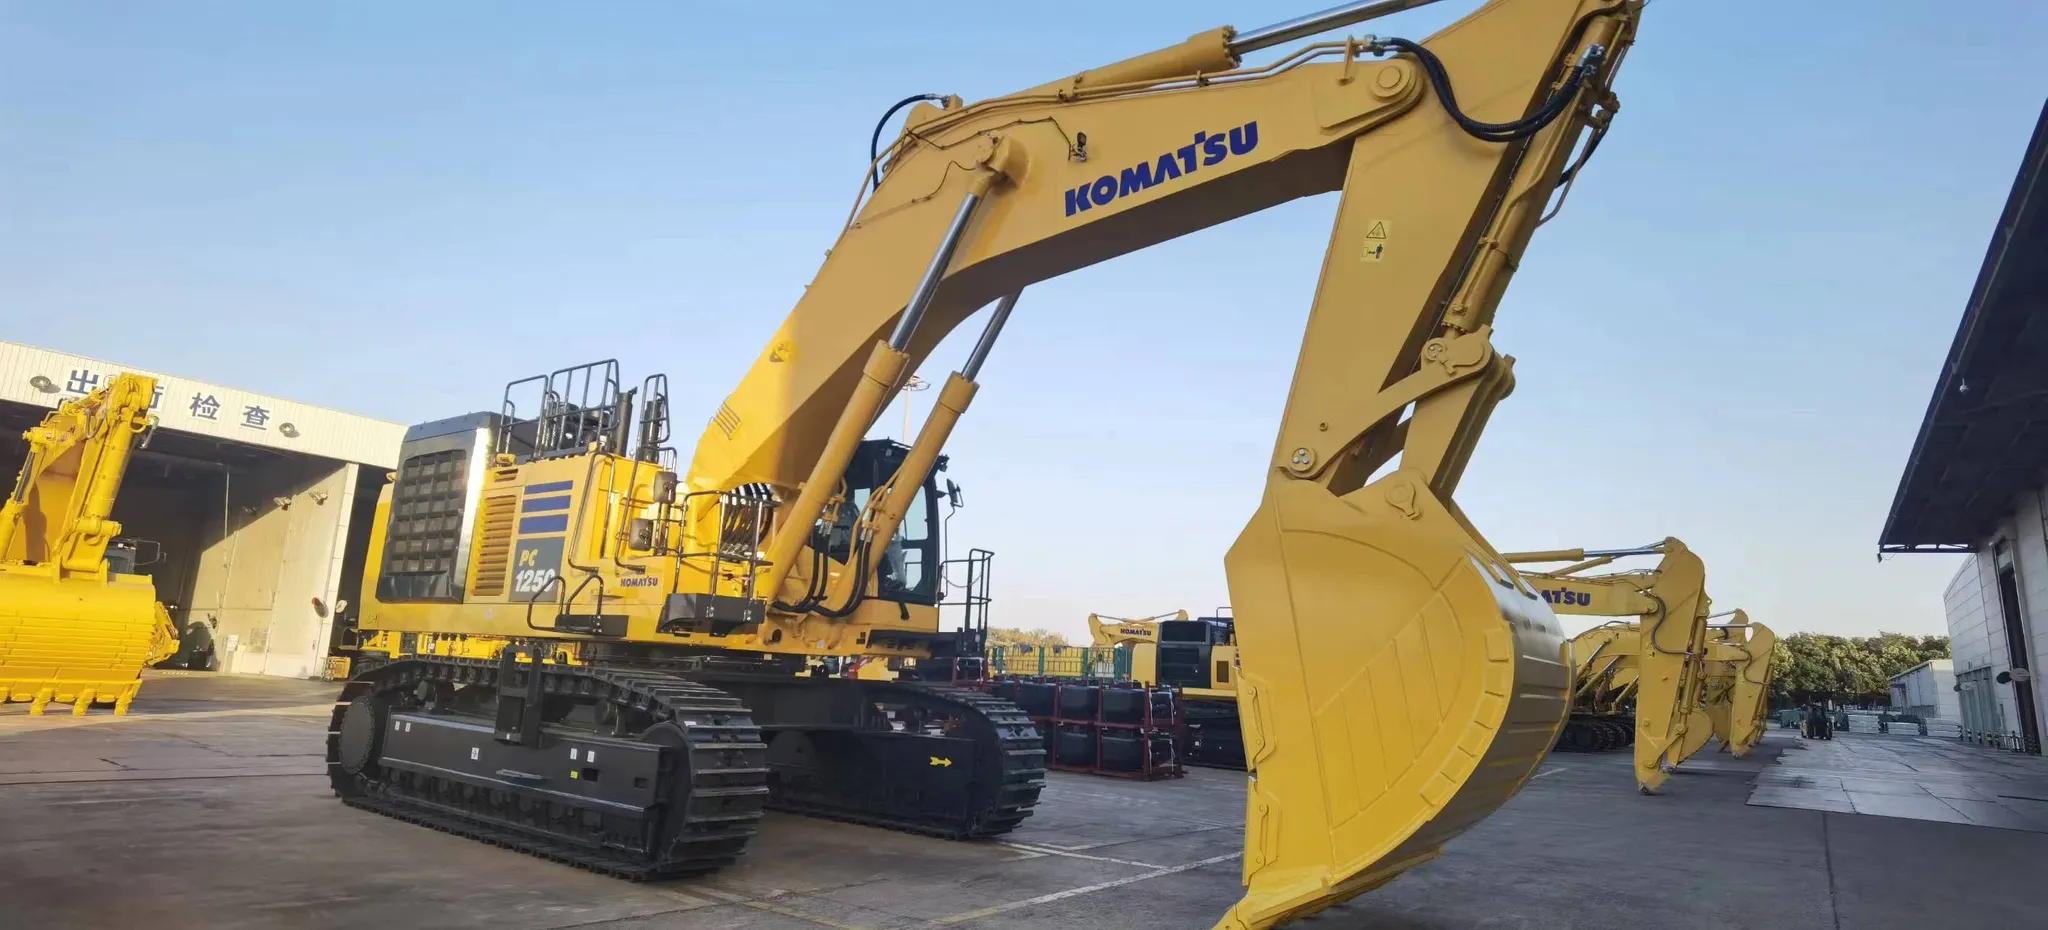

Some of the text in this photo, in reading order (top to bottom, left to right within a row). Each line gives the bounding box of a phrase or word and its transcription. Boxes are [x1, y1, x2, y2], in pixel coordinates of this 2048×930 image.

[1065, 121, 1258, 217] KOMATSU
[66, 369, 270, 431] 出检查
[519, 549, 538, 567] PC
[515, 568, 556, 592] 1250
[620, 575, 658, 587] KOMATSU
[1541, 586, 1591, 606] ATSU
[1120, 628, 1152, 636] KOMATSU
